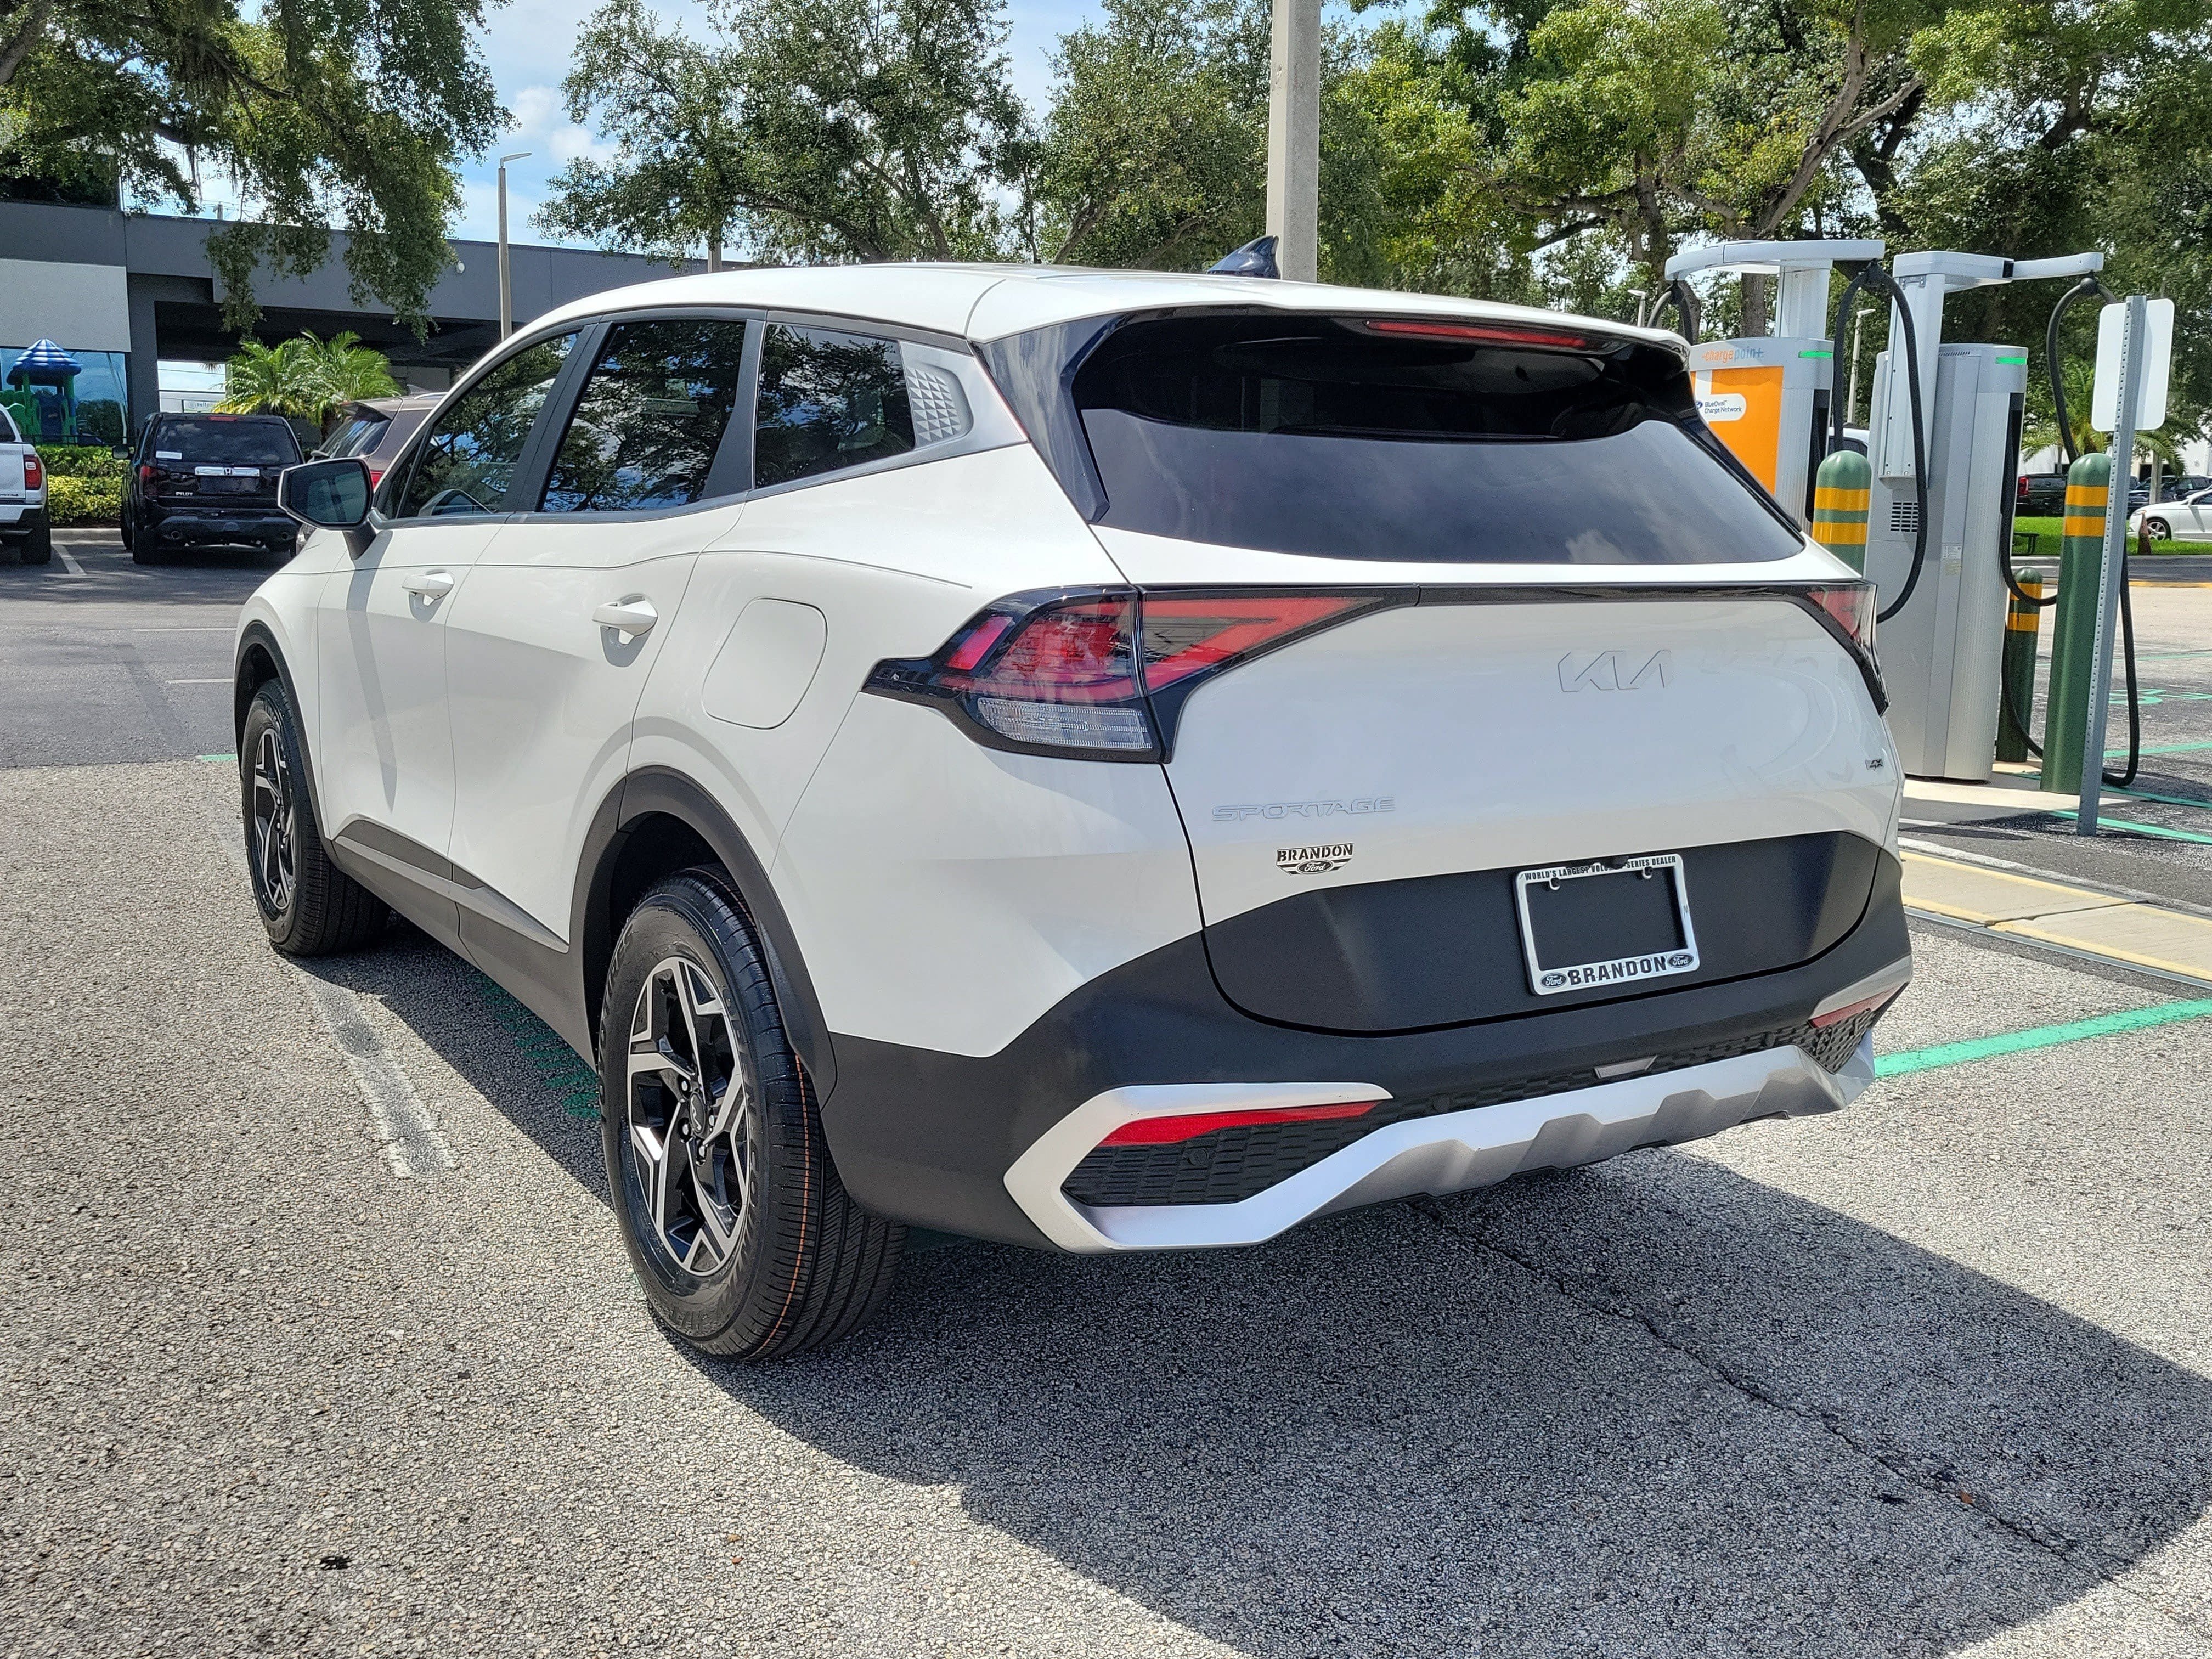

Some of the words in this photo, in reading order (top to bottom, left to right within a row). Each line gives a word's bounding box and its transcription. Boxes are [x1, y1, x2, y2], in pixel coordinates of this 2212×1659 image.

[1212, 796, 1396, 821] SPORTAGE
[1277, 843, 1353, 862] BRANDON
[1304, 862, 1326, 872] Ford
[1525, 870, 1557, 881] WORLD'S
[1559, 866, 1589, 877] LARGEST
[1652, 856, 1676, 868] DEALER
[1545, 975, 1562, 986] Ford
[1567, 956, 1668, 985] BRANDON
[1673, 955, 1690, 966] Ford
